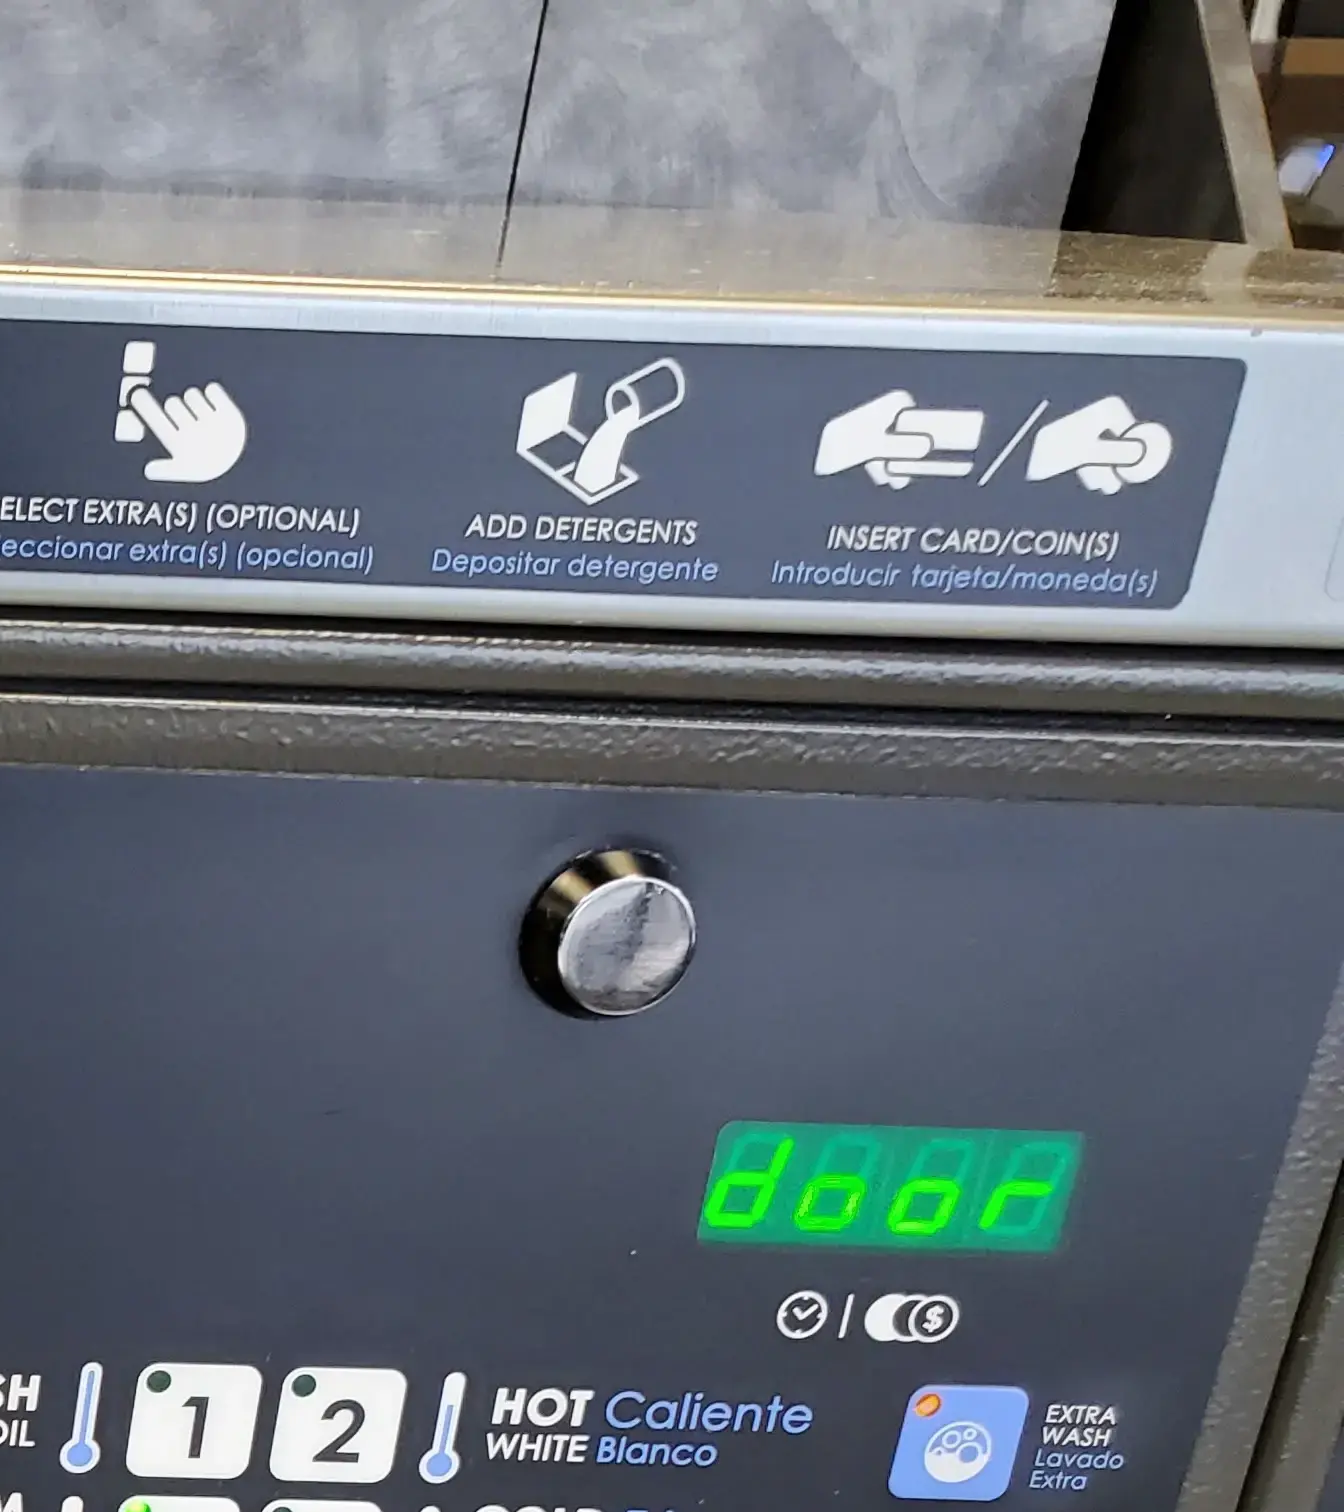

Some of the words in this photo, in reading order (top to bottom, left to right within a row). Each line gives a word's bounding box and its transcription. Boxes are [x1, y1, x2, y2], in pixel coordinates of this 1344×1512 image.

[82, 498, 198, 532] EXTRA(S)
[205, 503, 361, 538] (OPTIONAL)
[464, 513, 527, 540] ADD
[533, 516, 698, 546] DETERGENTS
[130, 539, 227, 570] extra(s)
[236, 543, 374, 573] (opcional)
[826, 525, 913, 552] INSERT
[919, 528, 1119, 561] CARD/COIN(S)
[431, 548, 563, 580] Depositar
[568, 553, 719, 586] detergente
[771, 560, 901, 589] Introducir
[911, 565, 1158, 598] tarjeta/moneda(s)
[704, 1137, 1054, 1236] door
[182, 1396, 210, 1459] 1
[491, 1388, 594, 1427] HOT
[605, 1390, 813, 1435] Caliente
[1045, 1404, 1117, 1425] EXTRA
[312, 1400, 366, 1462] 2
[1042, 1427, 1111, 1447] WASH
[486, 1433, 588, 1463] WHITE
[596, 1435, 718, 1467] Blanco
[1035, 1449, 1124, 1470] Lavado
[1029, 1470, 1087, 1490] Extra
